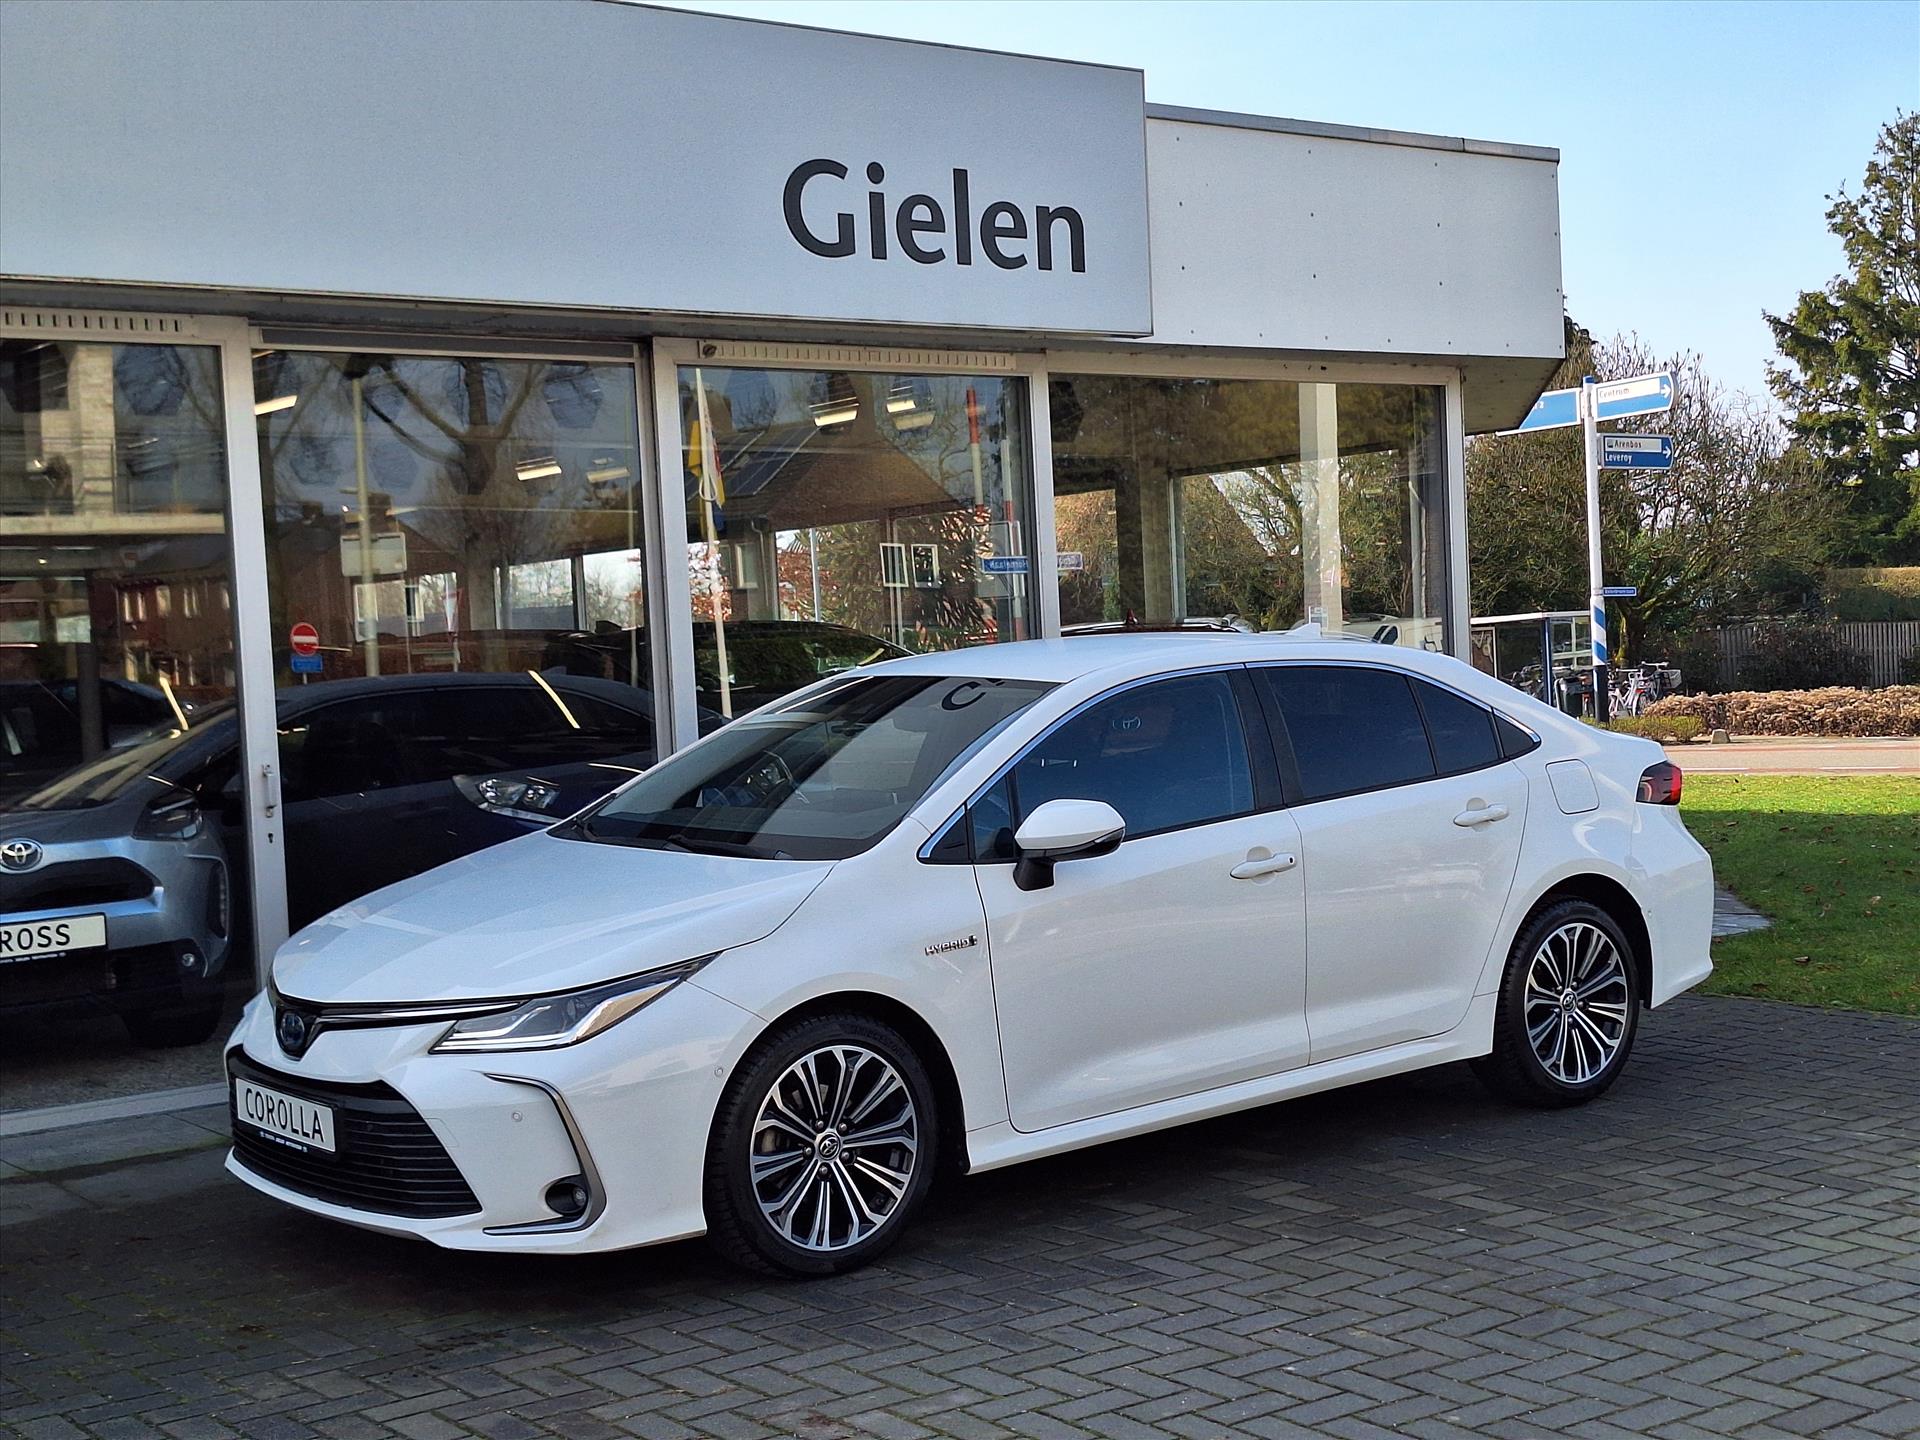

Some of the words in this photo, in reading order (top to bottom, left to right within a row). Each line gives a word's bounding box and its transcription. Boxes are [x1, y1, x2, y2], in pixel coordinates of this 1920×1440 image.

[783, 158, 1086, 273] Gielen
[1599, 388, 1630, 399] Centrum
[1614, 439, 1642, 449] Arenbos
[1605, 453, 1633, 465] Leveroy
[0, 923, 71, 953] ROSS
[924, 938, 971, 956] HYBRID
[245, 1087, 325, 1143] COROLLA
